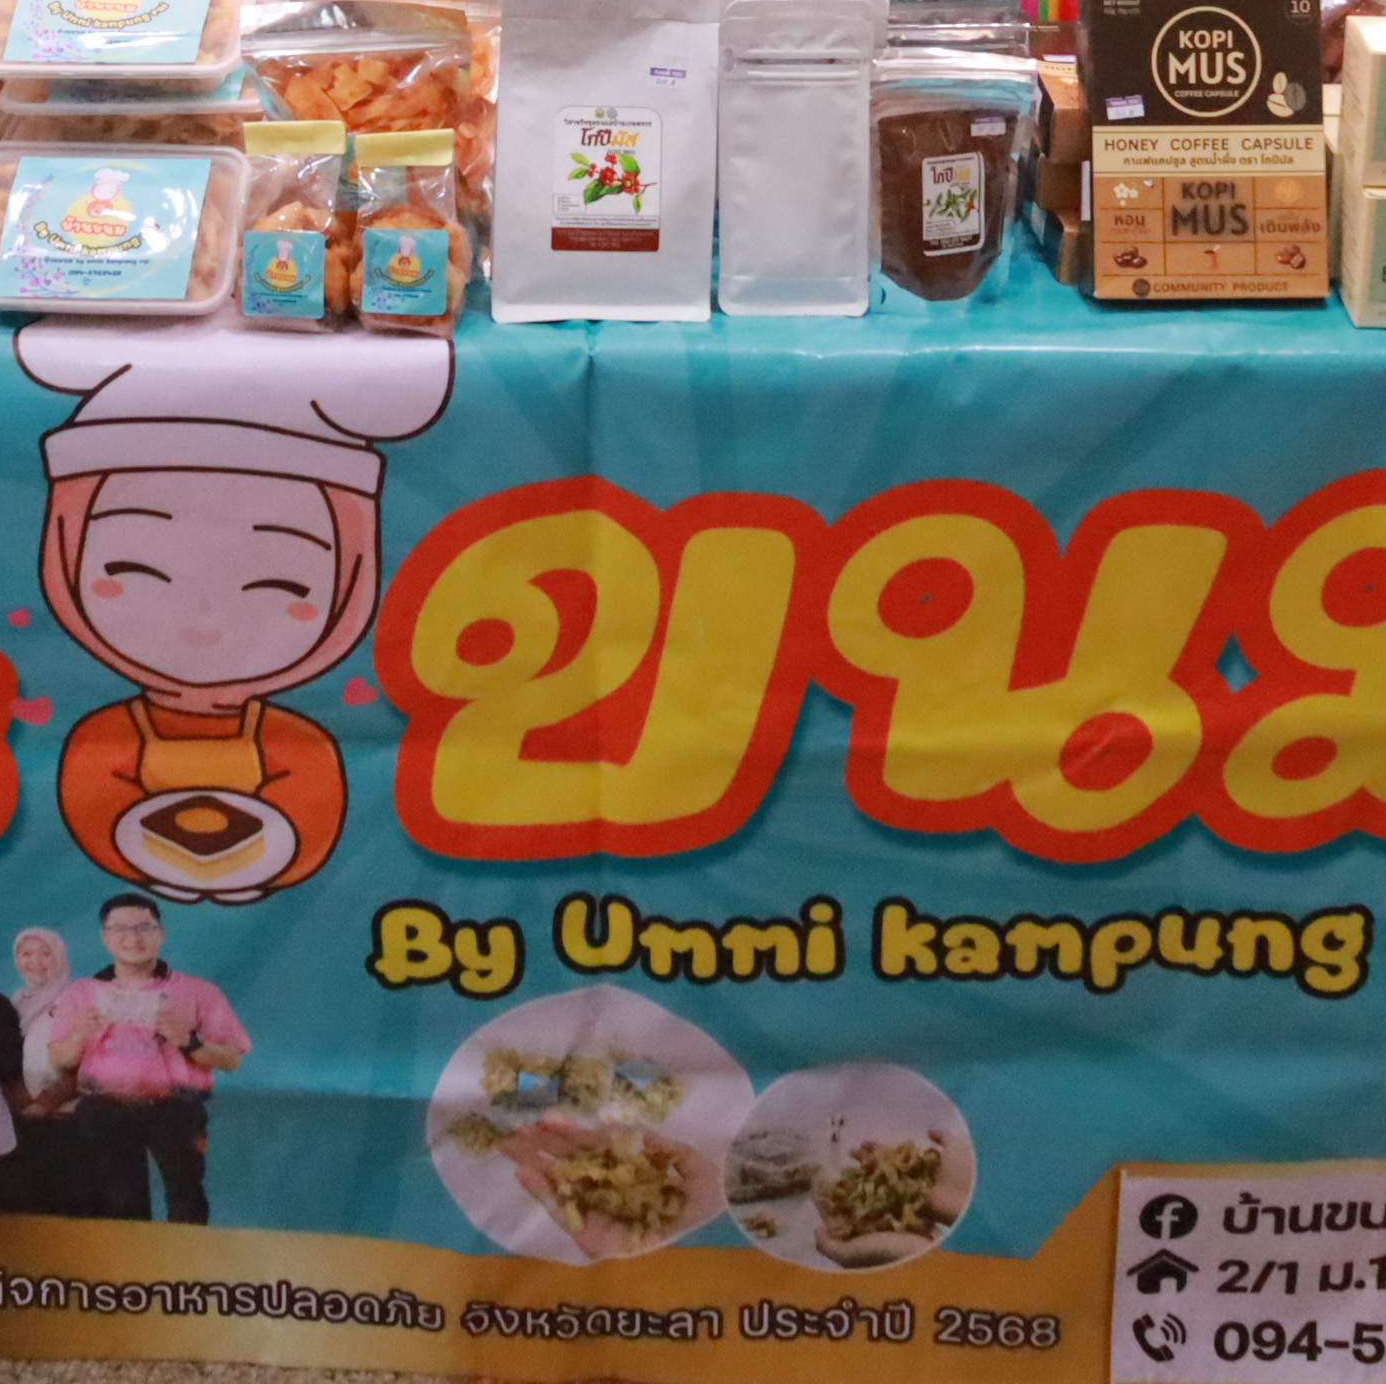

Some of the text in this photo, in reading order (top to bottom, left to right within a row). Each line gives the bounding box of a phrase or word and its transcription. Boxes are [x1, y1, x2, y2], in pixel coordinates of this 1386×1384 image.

[1290, 0, 1311, 14] 10
[1179, 30, 1233, 49] KOPI
[1168, 51, 1247, 85] MUS
[1174, 89, 1240, 98] COFFEE CAPSULE
[580, 127, 641, 147] โกปีมัส
[1104, 137, 1314, 151] HONEY COFFEE CAPSULE
[1181, 182, 1235, 200] KOPI
[60, 215, 127, 236] บ้านขนม
[1172, 204, 1249, 236] MUS
[1153, 281, 1289, 293] COMMUNITY PRODUCT
[367, 900, 524, 999] By
[554, 893, 845, 984] Ummi
[874, 896, 1372, 1000] kampung
[1216, 1259, 1300, 1295] 2/1
[461, 1298, 724, 1342] จังหวัดยะลา
[739, 1297, 913, 1343] ประจำปี
[934, 1306, 1061, 1349] 2568
